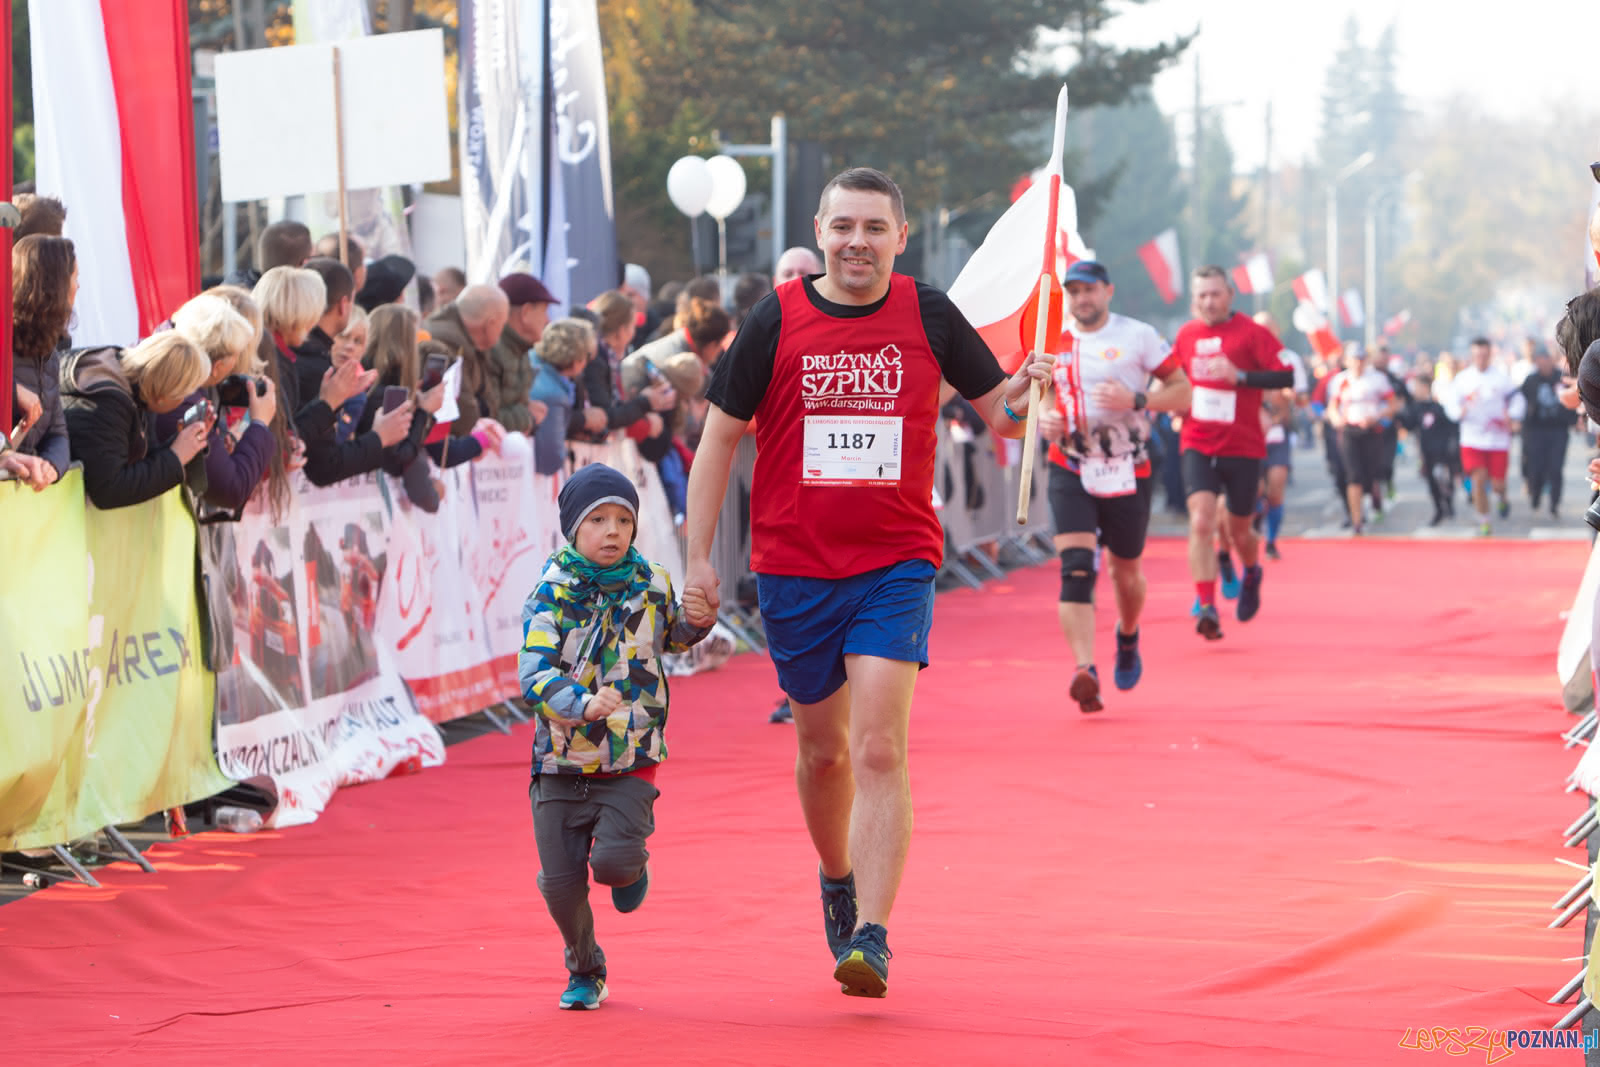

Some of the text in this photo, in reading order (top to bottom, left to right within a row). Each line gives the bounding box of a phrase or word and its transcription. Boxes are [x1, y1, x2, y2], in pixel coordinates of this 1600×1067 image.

[801, 350, 885, 371] DRUŻYNA
[801, 368, 904, 397] SZPIKU
[804, 399, 895, 412] www.darszpiku.pl
[828, 433, 876, 449] 1187
